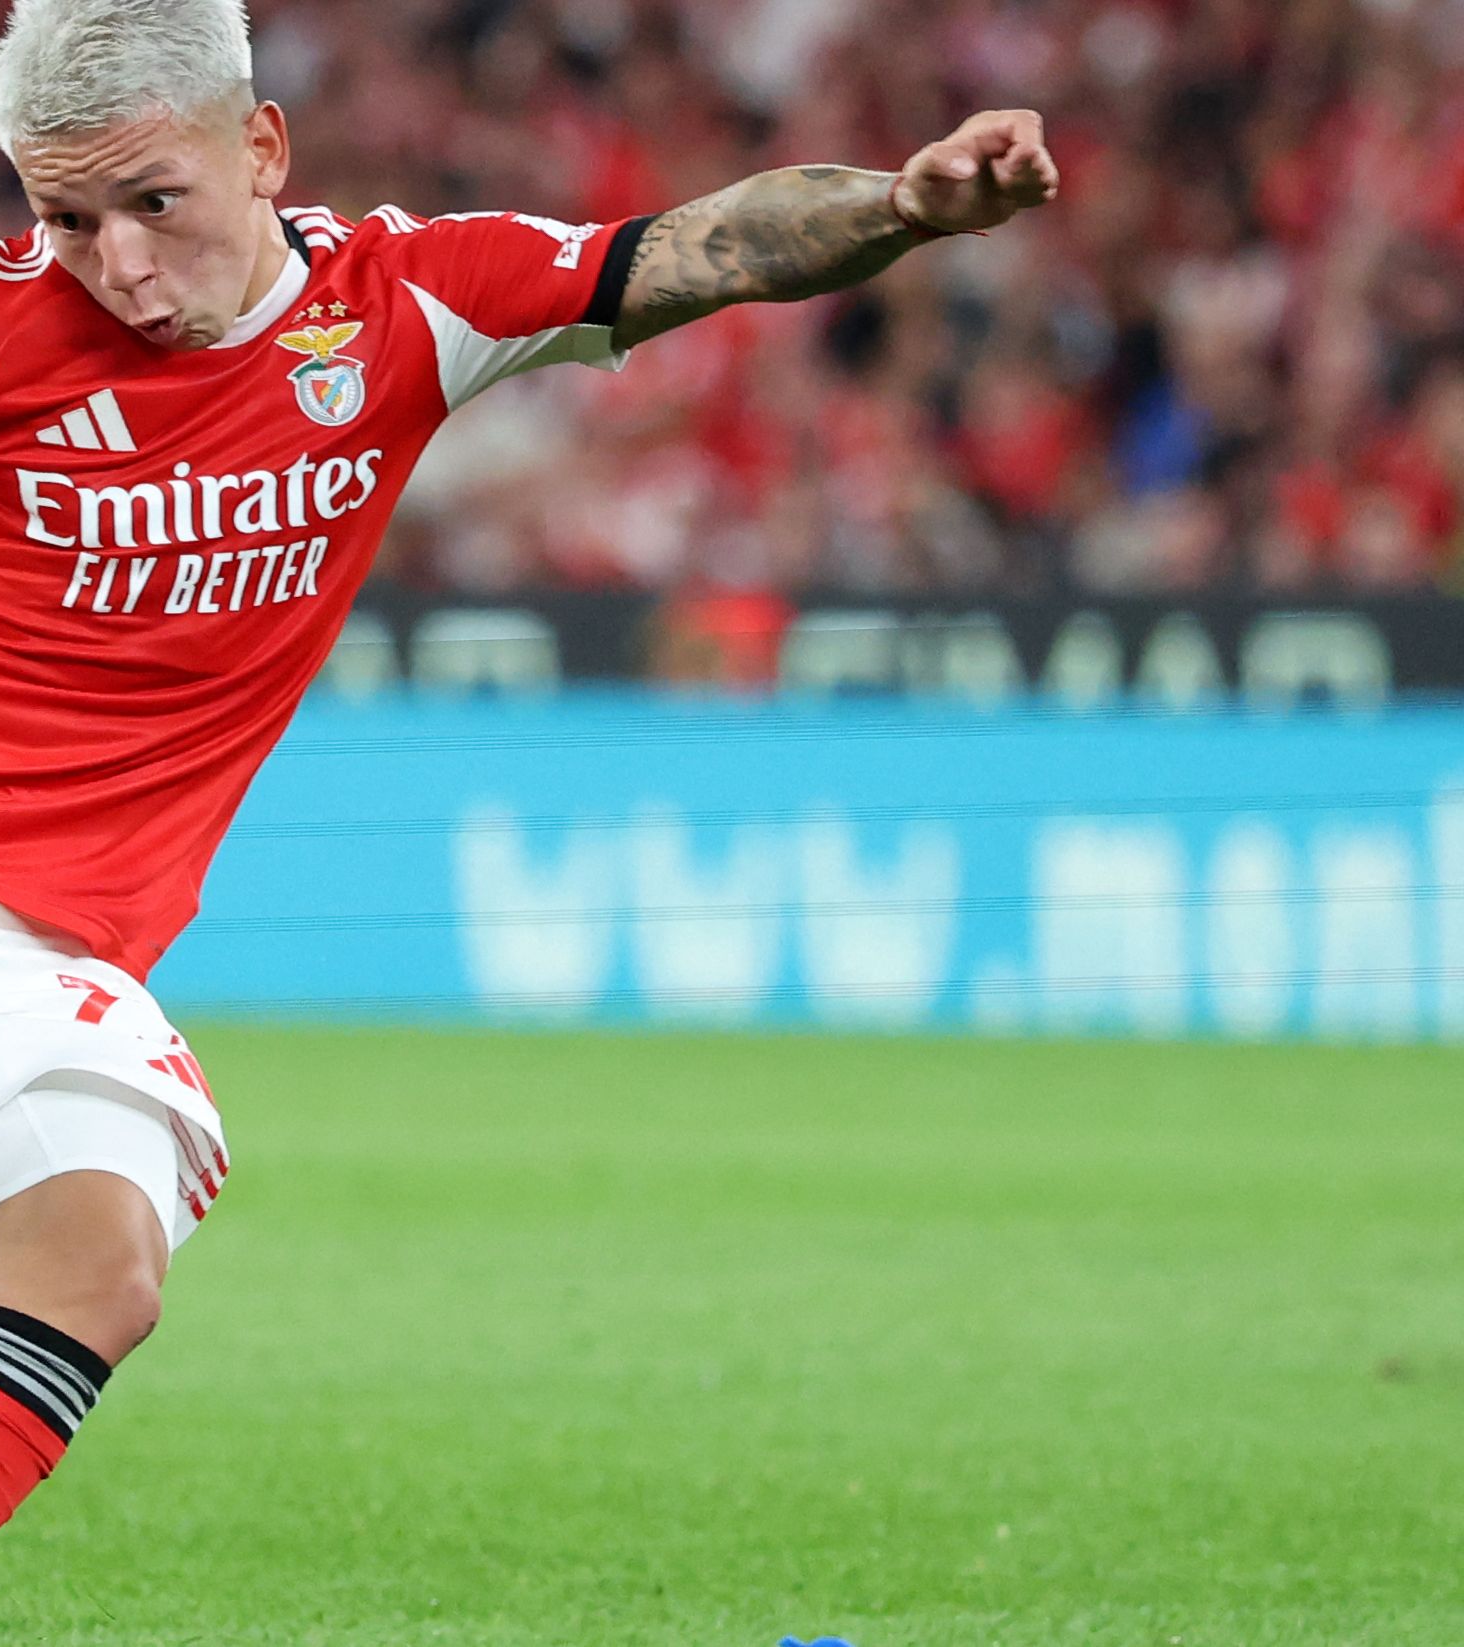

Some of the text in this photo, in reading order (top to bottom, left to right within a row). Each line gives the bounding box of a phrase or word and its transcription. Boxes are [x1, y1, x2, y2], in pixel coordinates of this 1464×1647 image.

[16, 449, 383, 548] Emirates
[61, 535, 329, 614] FLY BETTER
